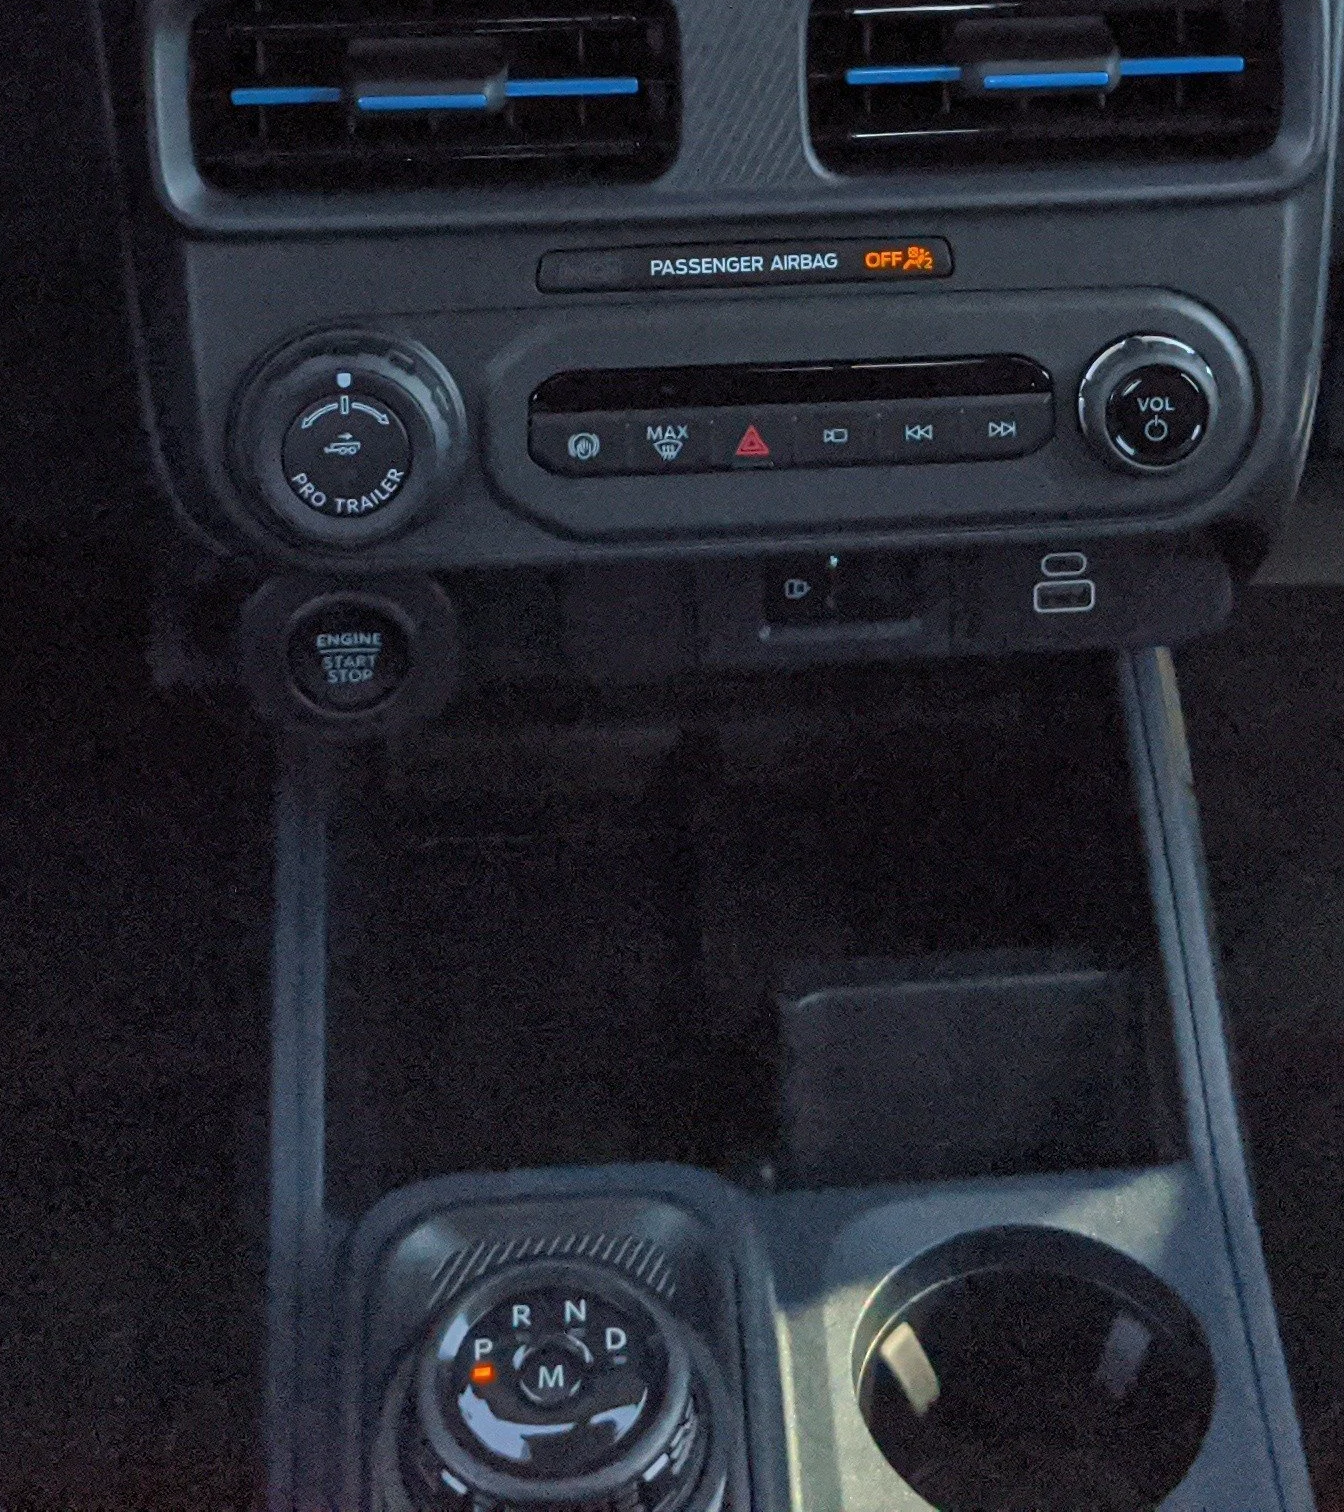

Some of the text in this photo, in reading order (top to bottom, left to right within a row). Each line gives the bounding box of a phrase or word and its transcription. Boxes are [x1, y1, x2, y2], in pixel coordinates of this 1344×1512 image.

[650, 255, 764, 277] PASSENGER
[770, 252, 838, 272] AIRBAG
[864, 250, 903, 270] OFF
[1136, 396, 1176, 414] VOL
[646, 424, 690, 444] MAX
[291, 467, 404, 514] PRO TRAILER
[316, 632, 382, 649] ENGINE
[322, 654, 378, 671] START
[327, 668, 374, 684] STOP
[474, 1299, 628, 1360] P R N D
[537, 1364, 565, 1389] M
